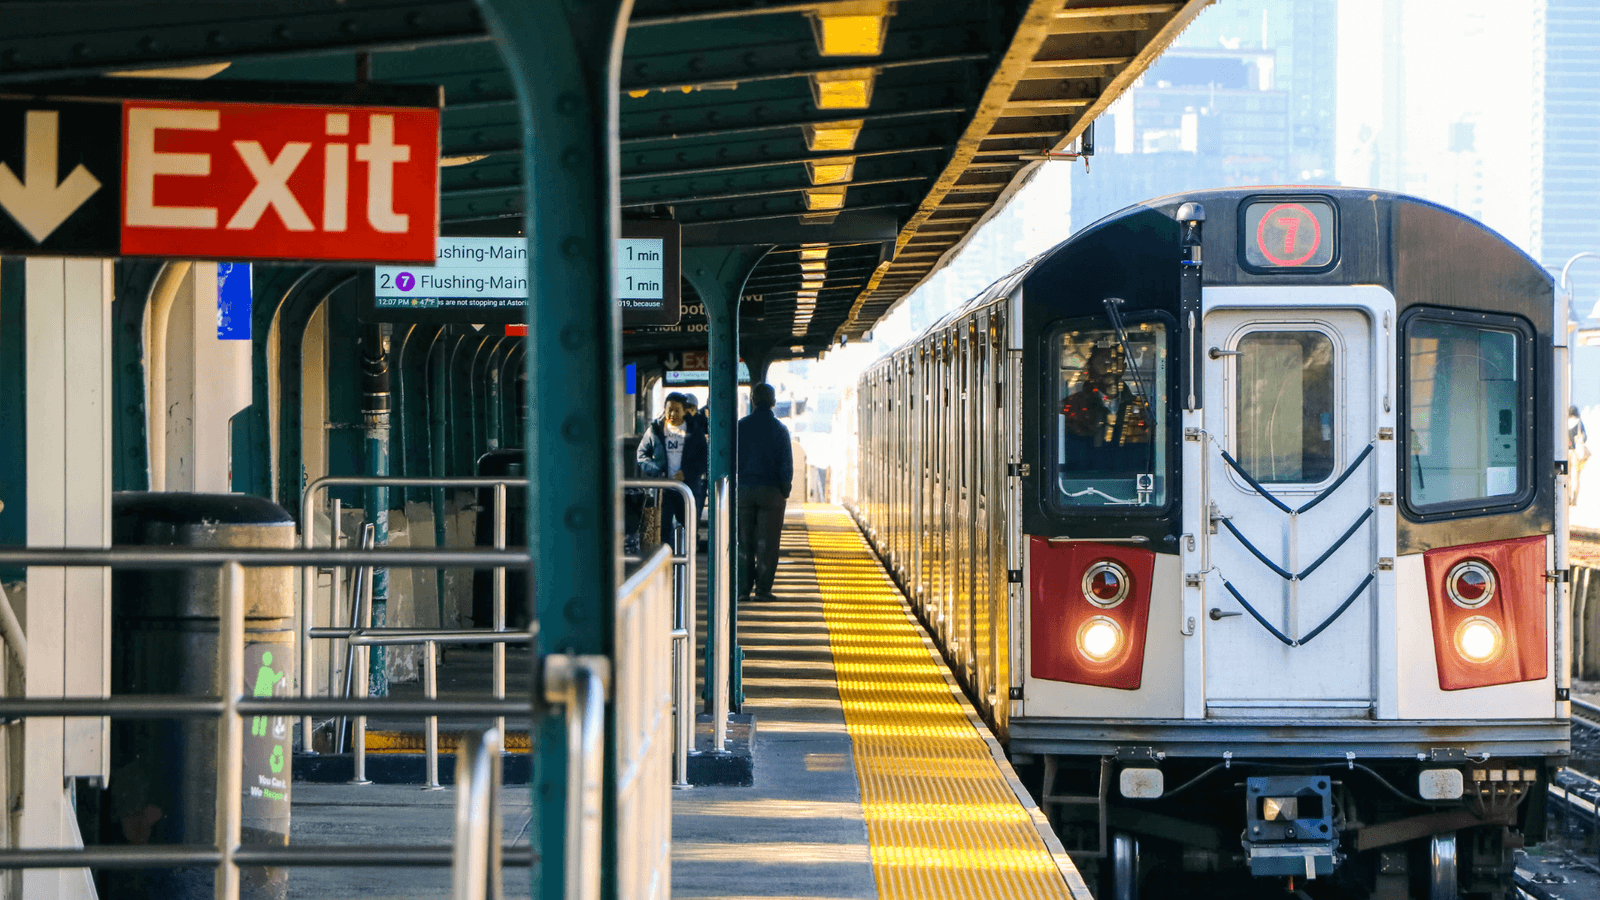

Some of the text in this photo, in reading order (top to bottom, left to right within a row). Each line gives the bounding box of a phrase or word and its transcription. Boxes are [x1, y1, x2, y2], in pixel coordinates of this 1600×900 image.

[125, 107, 412, 234] Exit
[1278, 217, 1301, 254] 7
[626, 246, 633, 261] 1
[638, 250, 660, 261] min
[421, 275, 527, 292] Flushing-Main
[626, 276, 633, 291] 1
[638, 280, 660, 291] min
[469, 299, 498, 307] stopping
[615, 300, 632, 308] 019,
